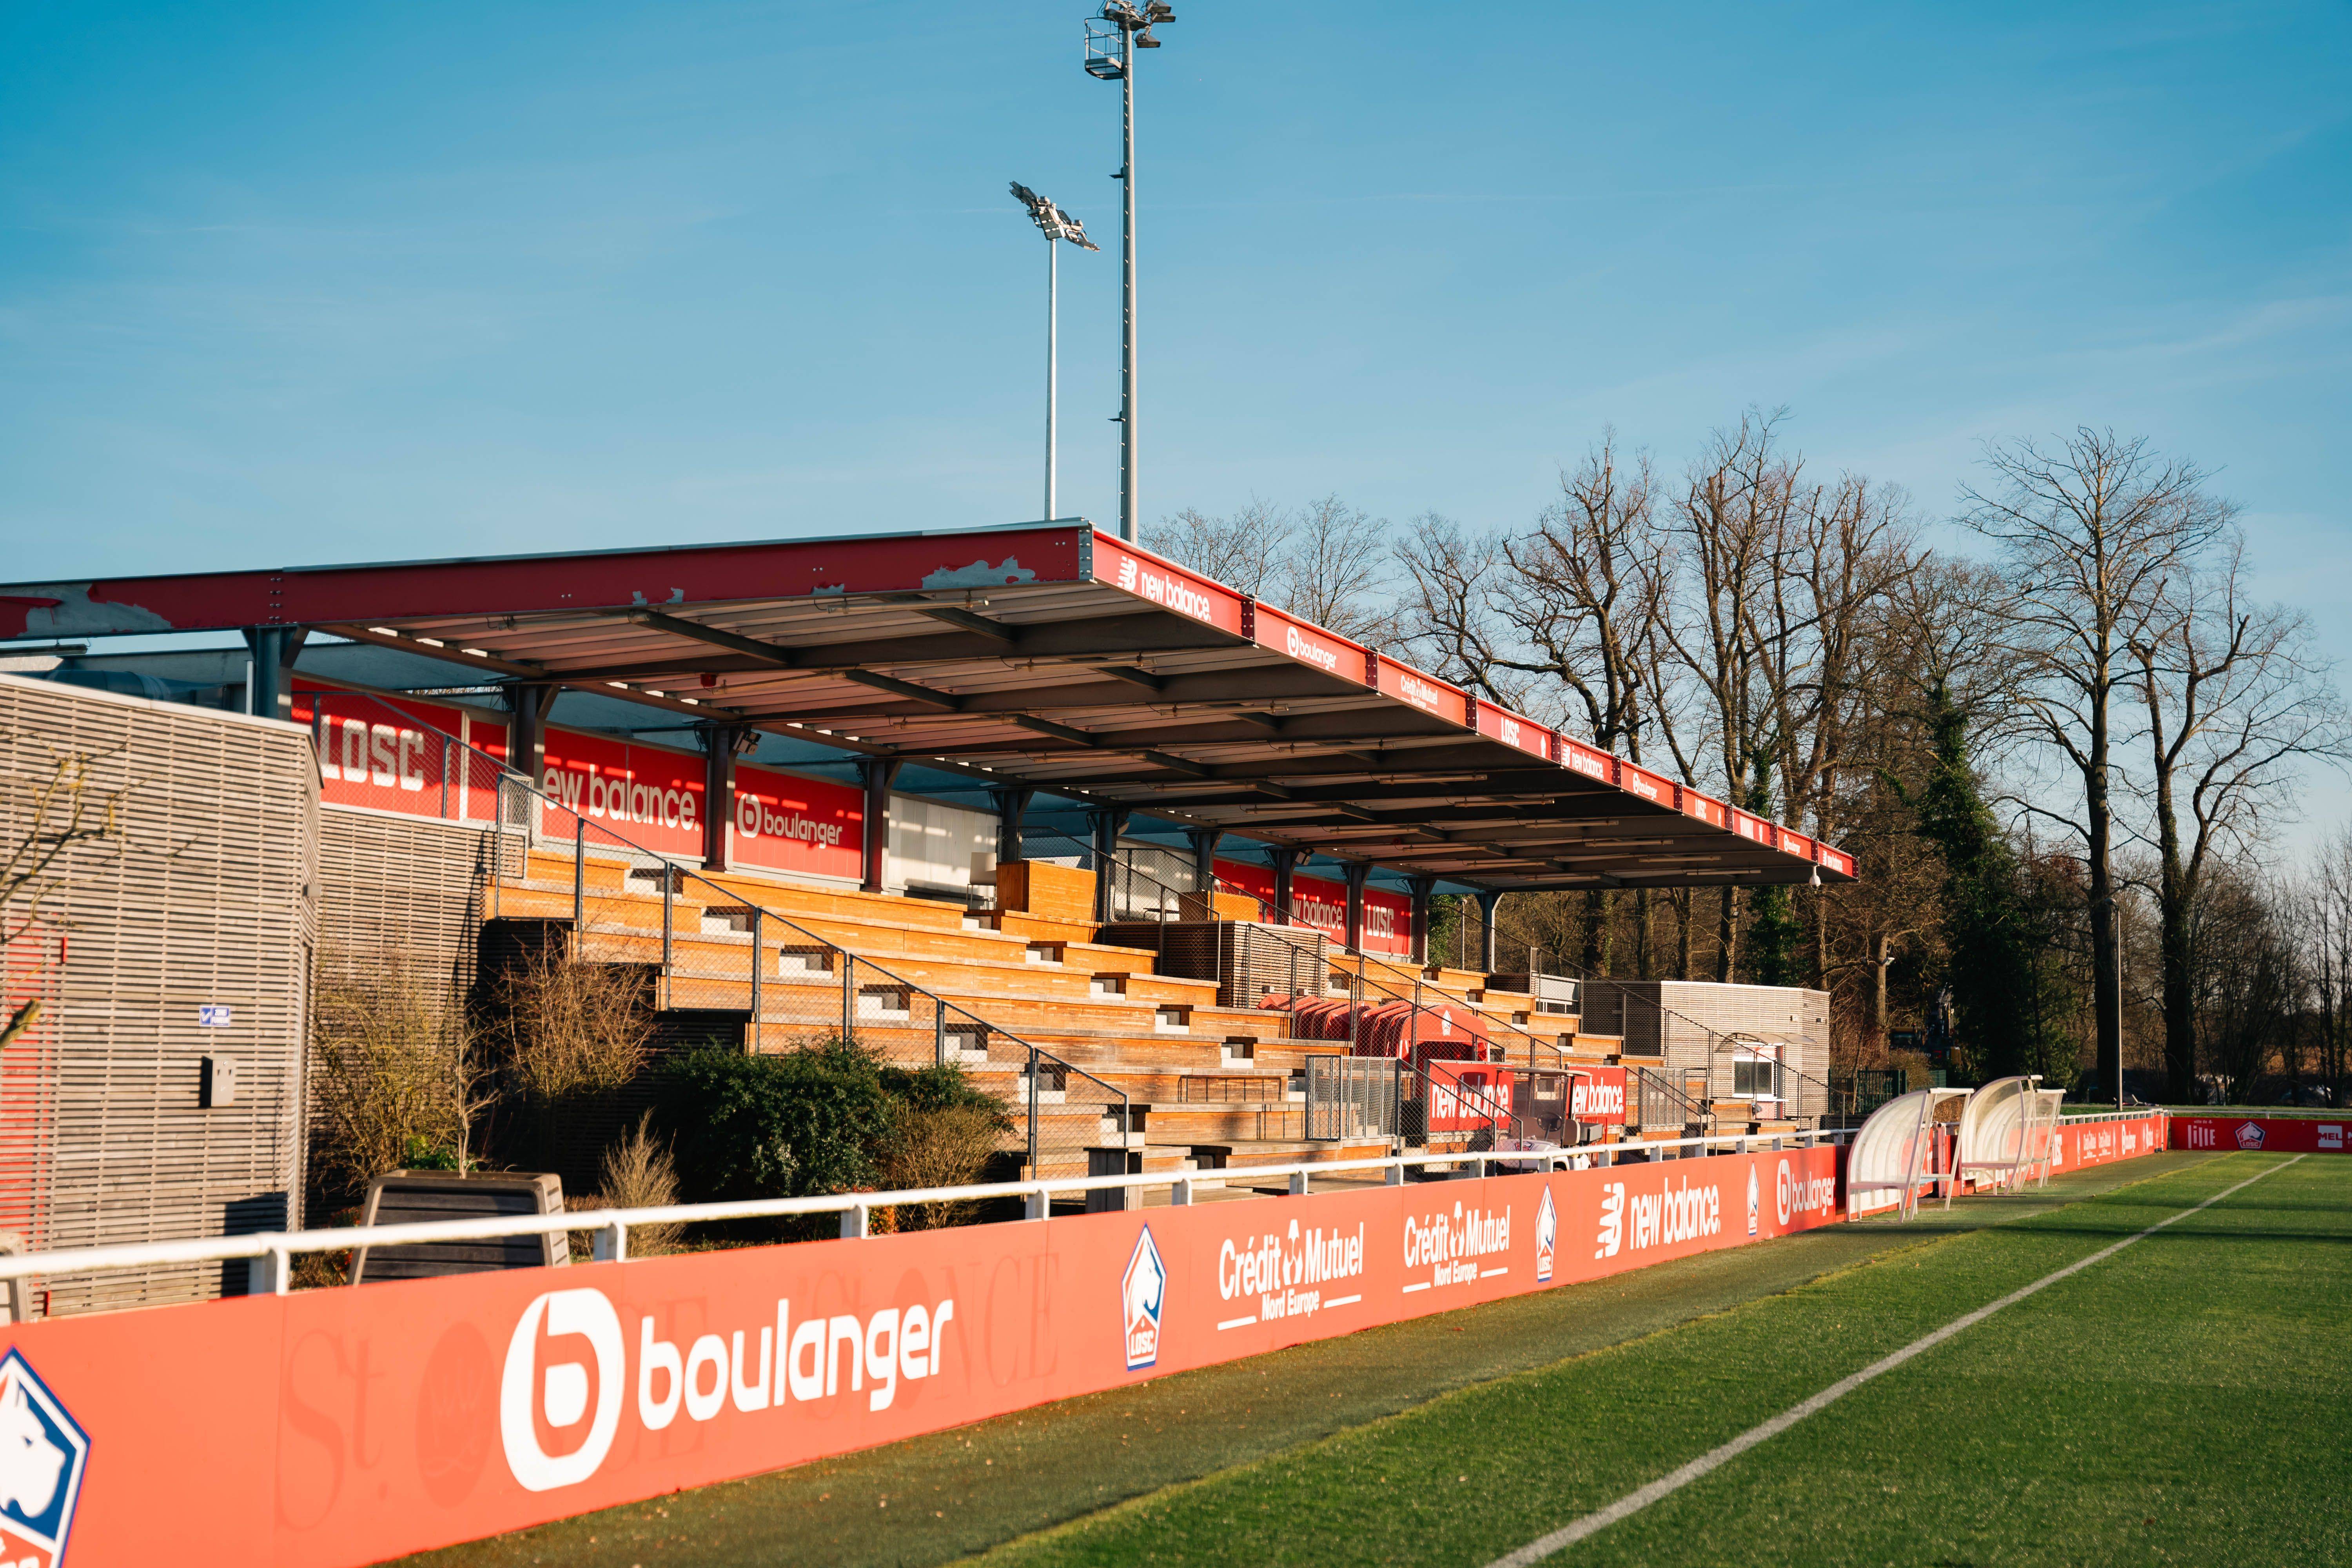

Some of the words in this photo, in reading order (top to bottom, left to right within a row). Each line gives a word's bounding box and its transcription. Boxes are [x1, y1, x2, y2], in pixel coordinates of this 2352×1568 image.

[1142, 572, 1164, 603] new
[1299, 637, 1336, 670] boulanger
[1401, 675, 1416, 696] Crédit
[1421, 684, 1438, 706] Mutuel
[1501, 717, 1519, 747] LOSC
[319, 715, 423, 791] LOSC
[543, 768, 583, 813] ew
[1639, 779, 1657, 800] boulanger
[1695, 798, 1706, 820] LOSC
[764, 807, 842, 849] boulanger
[1367, 904, 1394, 939] LOSC
[1432, 1083, 1458, 1119] new
[2318, 1132, 2342, 1140] MEL
[1792, 1171, 1835, 1216] boulanger
[1404, 1213, 1449, 1268] Crédit
[1466, 1205, 1510, 1257] Mutuel
[1630, 1194, 1662, 1250] new
[1219, 1234, 1281, 1300] Crédit
[1305, 1221, 1364, 1285] Mutuel
[1434, 1261, 1452, 1287] Nord
[1453, 1260, 1477, 1285] Europe
[1540, 1255, 1551, 1272] LOSC
[1261, 1290, 1285, 1321] Nord
[1287, 1289, 1319, 1318] Europe
[1131, 1330, 1154, 1356] LOSC
[639, 1298, 953, 1430] boulanger
